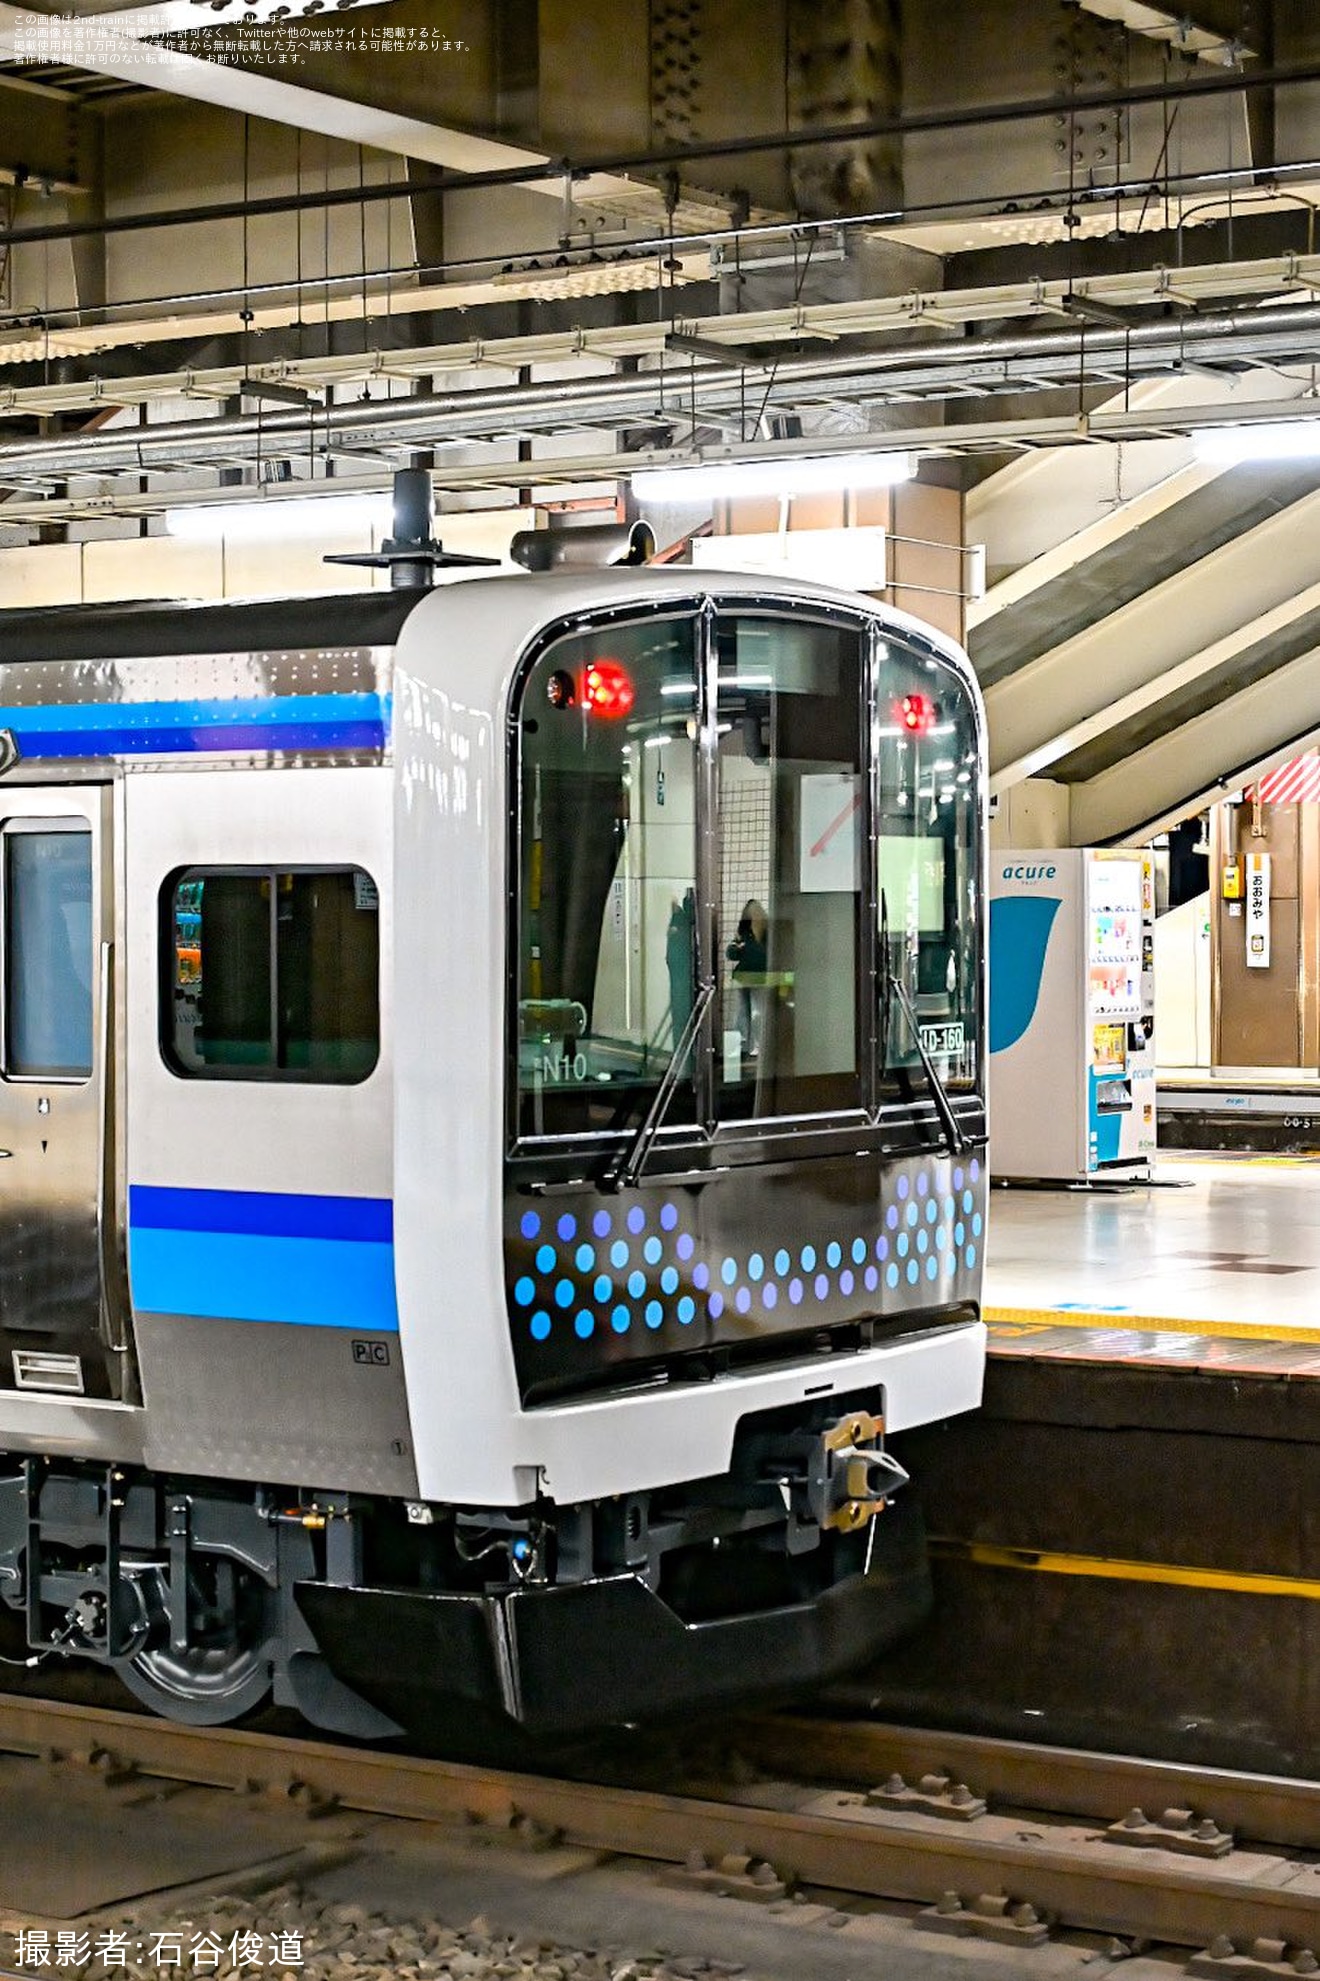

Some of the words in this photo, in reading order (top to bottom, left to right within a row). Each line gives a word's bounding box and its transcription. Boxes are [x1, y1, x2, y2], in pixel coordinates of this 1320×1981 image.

[1002, 866, 1056, 879] acure
[1253, 875, 1263, 919] おおみや
[543, 1053, 587, 1082] N10
